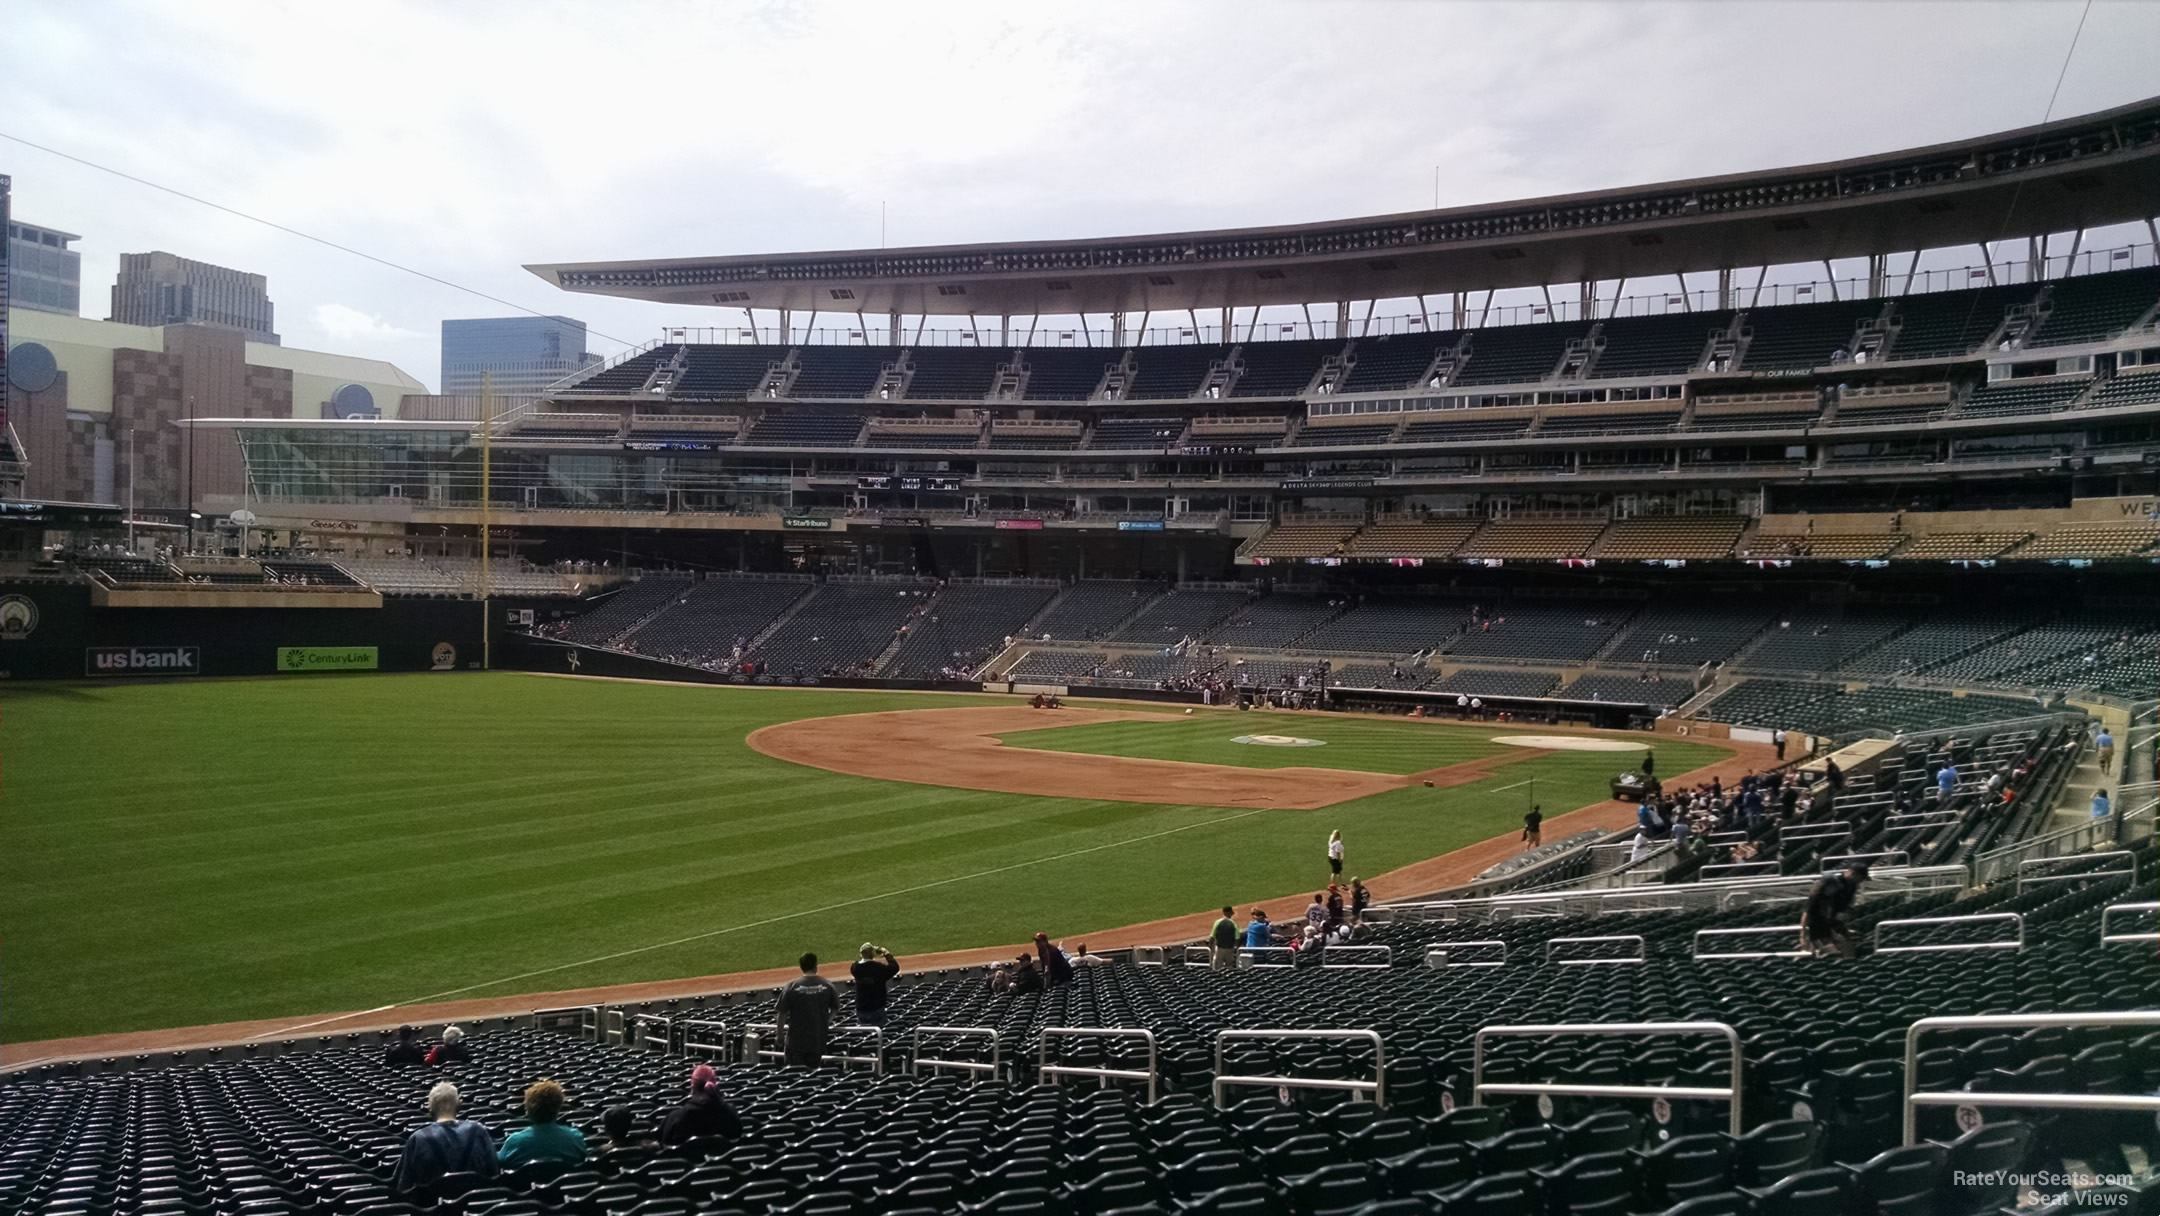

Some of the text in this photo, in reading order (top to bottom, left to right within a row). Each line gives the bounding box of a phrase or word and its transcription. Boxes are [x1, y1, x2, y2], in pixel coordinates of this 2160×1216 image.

[1767, 370, 1783, 378] OUR
[1785, 368, 1812, 377] FAMILY
[308, 653, 370, 664] CenturyLink
[1310, 911, 1323, 922] 33
